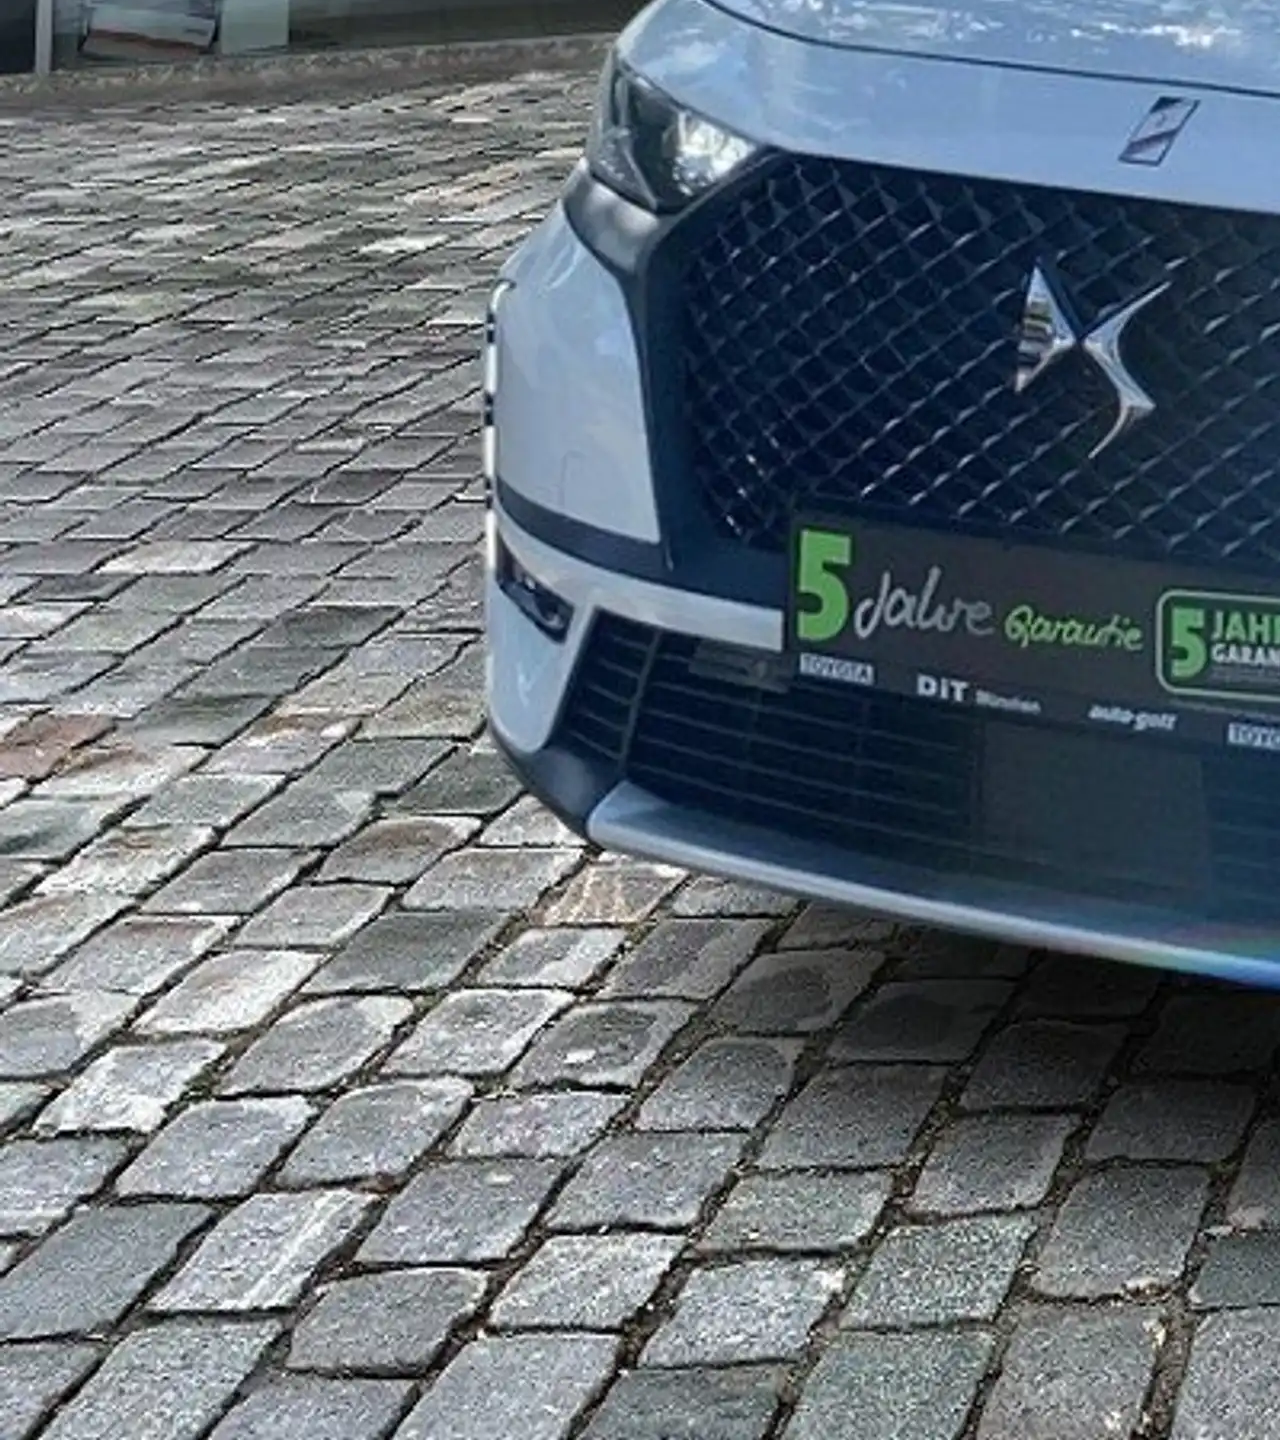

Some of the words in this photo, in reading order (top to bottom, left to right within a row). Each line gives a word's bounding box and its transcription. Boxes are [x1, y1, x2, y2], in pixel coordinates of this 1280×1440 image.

[798, 530, 851, 641] 5
[801, 653, 874, 685] TOYOTA
[1171, 607, 1207, 678] 5
